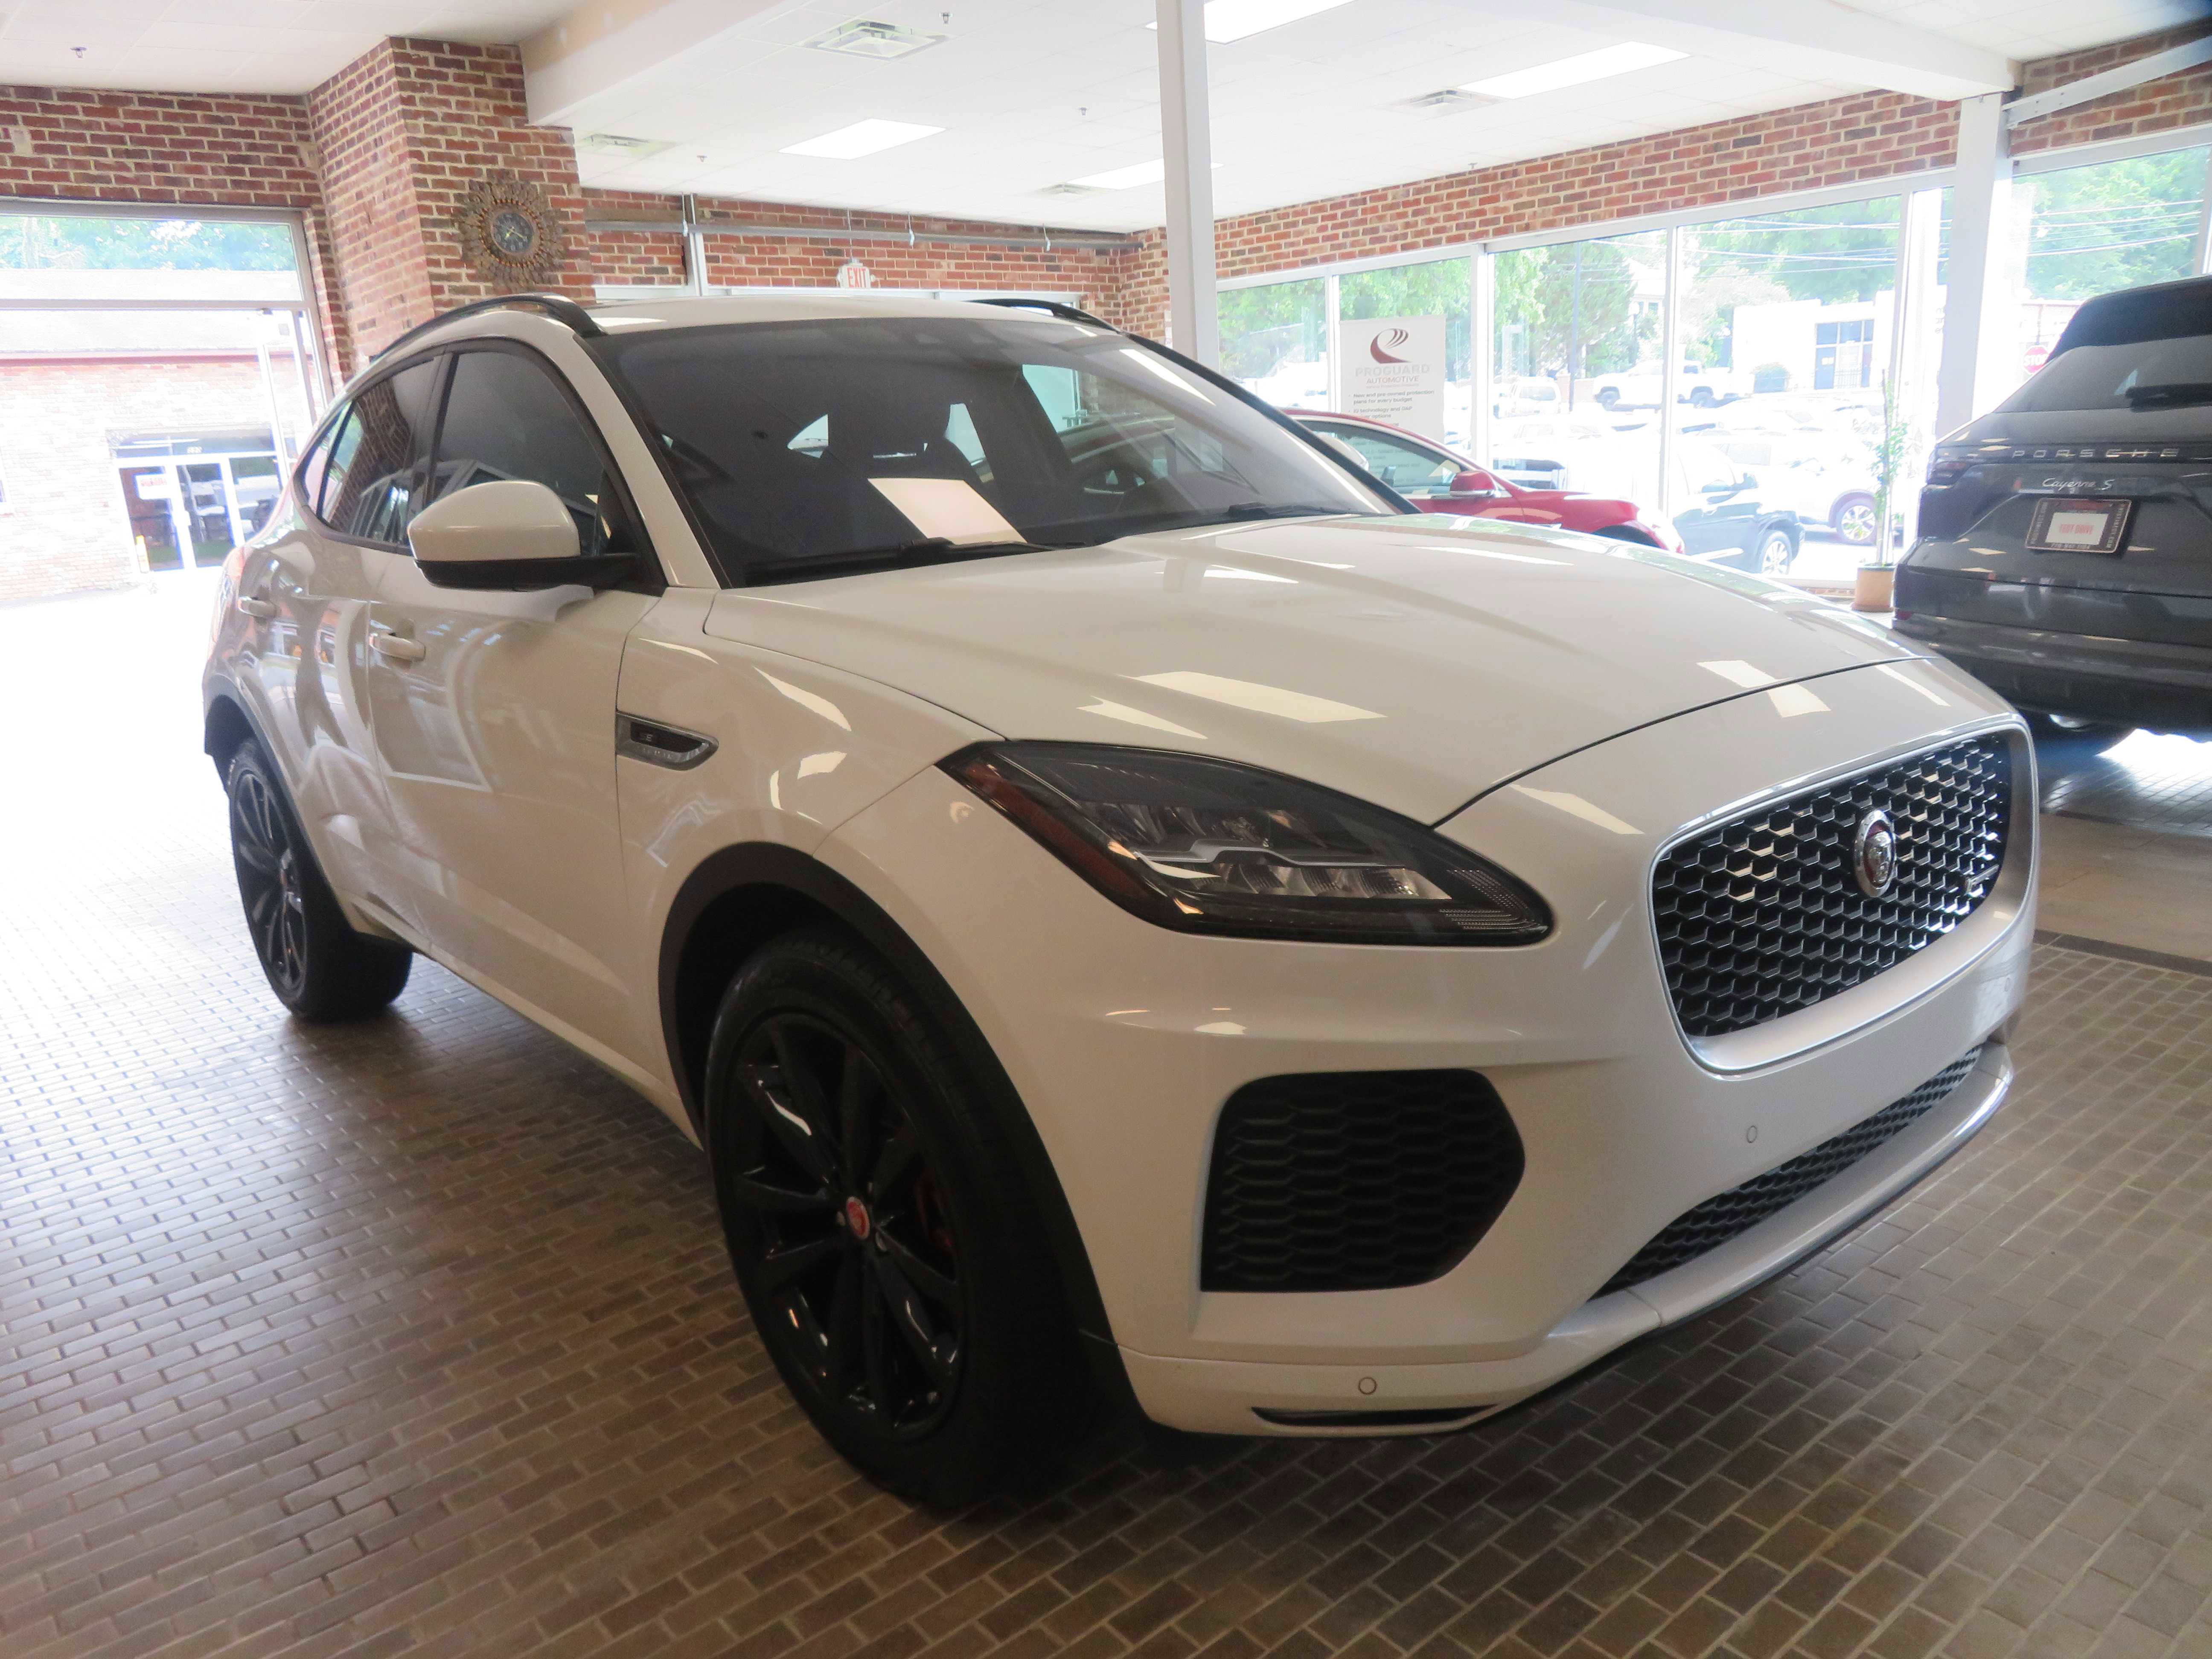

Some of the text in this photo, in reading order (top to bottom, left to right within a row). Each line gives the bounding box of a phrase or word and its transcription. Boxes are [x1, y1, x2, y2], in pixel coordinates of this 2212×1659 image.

[847, 267, 866, 287] EXIT
[1355, 364, 1430, 377] PROGUARD
[1366, 375, 1420, 384] AUTOMOTIVE
[2012, 448, 2179, 458] PORSCHE
[2042, 477, 2115, 491] Cayenne S
